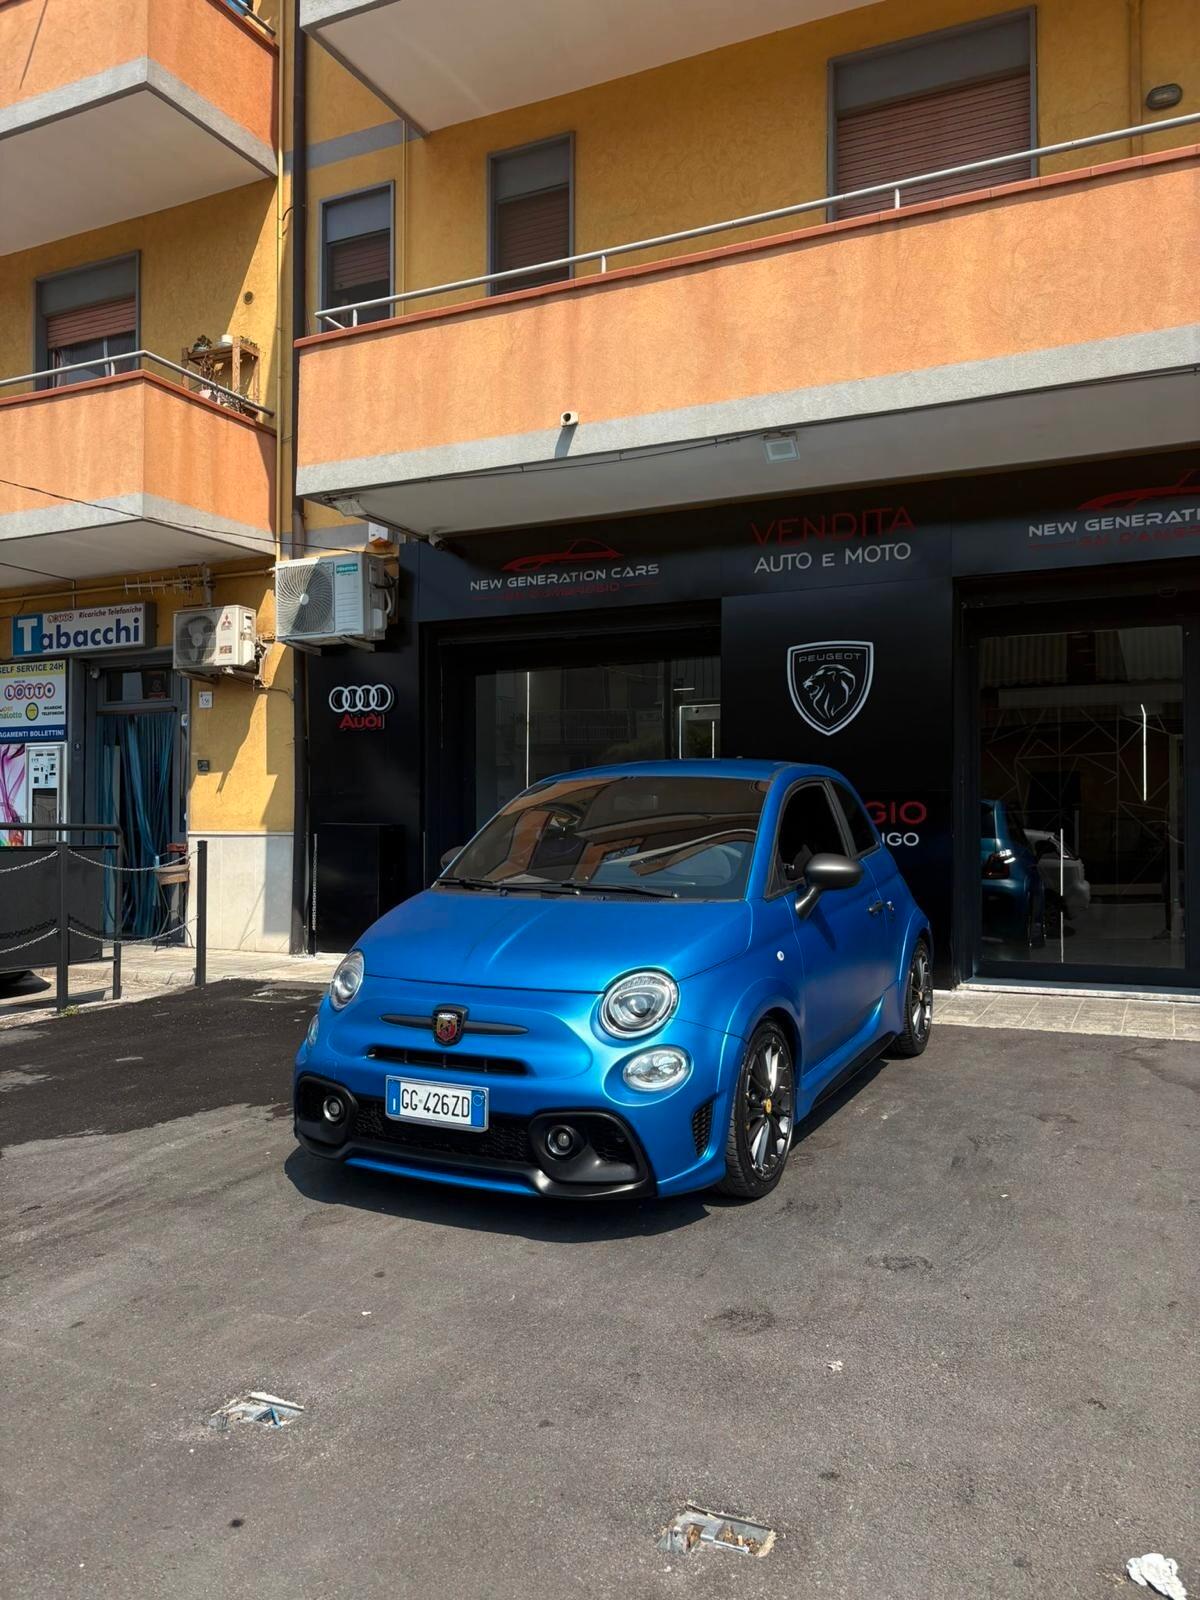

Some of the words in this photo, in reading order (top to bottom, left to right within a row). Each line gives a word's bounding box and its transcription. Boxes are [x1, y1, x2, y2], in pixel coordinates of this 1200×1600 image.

[750, 506, 916, 547] VENDITA
[1028, 521, 1077, 537] NEW
[753, 552, 811, 574] AUTO
[821, 553, 835, 567] E
[845, 542, 911, 565] MOTO
[470, 578, 502, 591] NEW
[506, 568, 607, 589] GENERATION
[611, 563, 660, 578] CARS
[18, 617, 140, 652] Tabacchi
[16, 663, 47, 673] SERVICE
[49, 661, 64, 671] 24H
[799, 652, 861, 663] PEUGEOT
[4, 682, 55, 701] LOTTO
[338, 712, 384, 730] Audi
